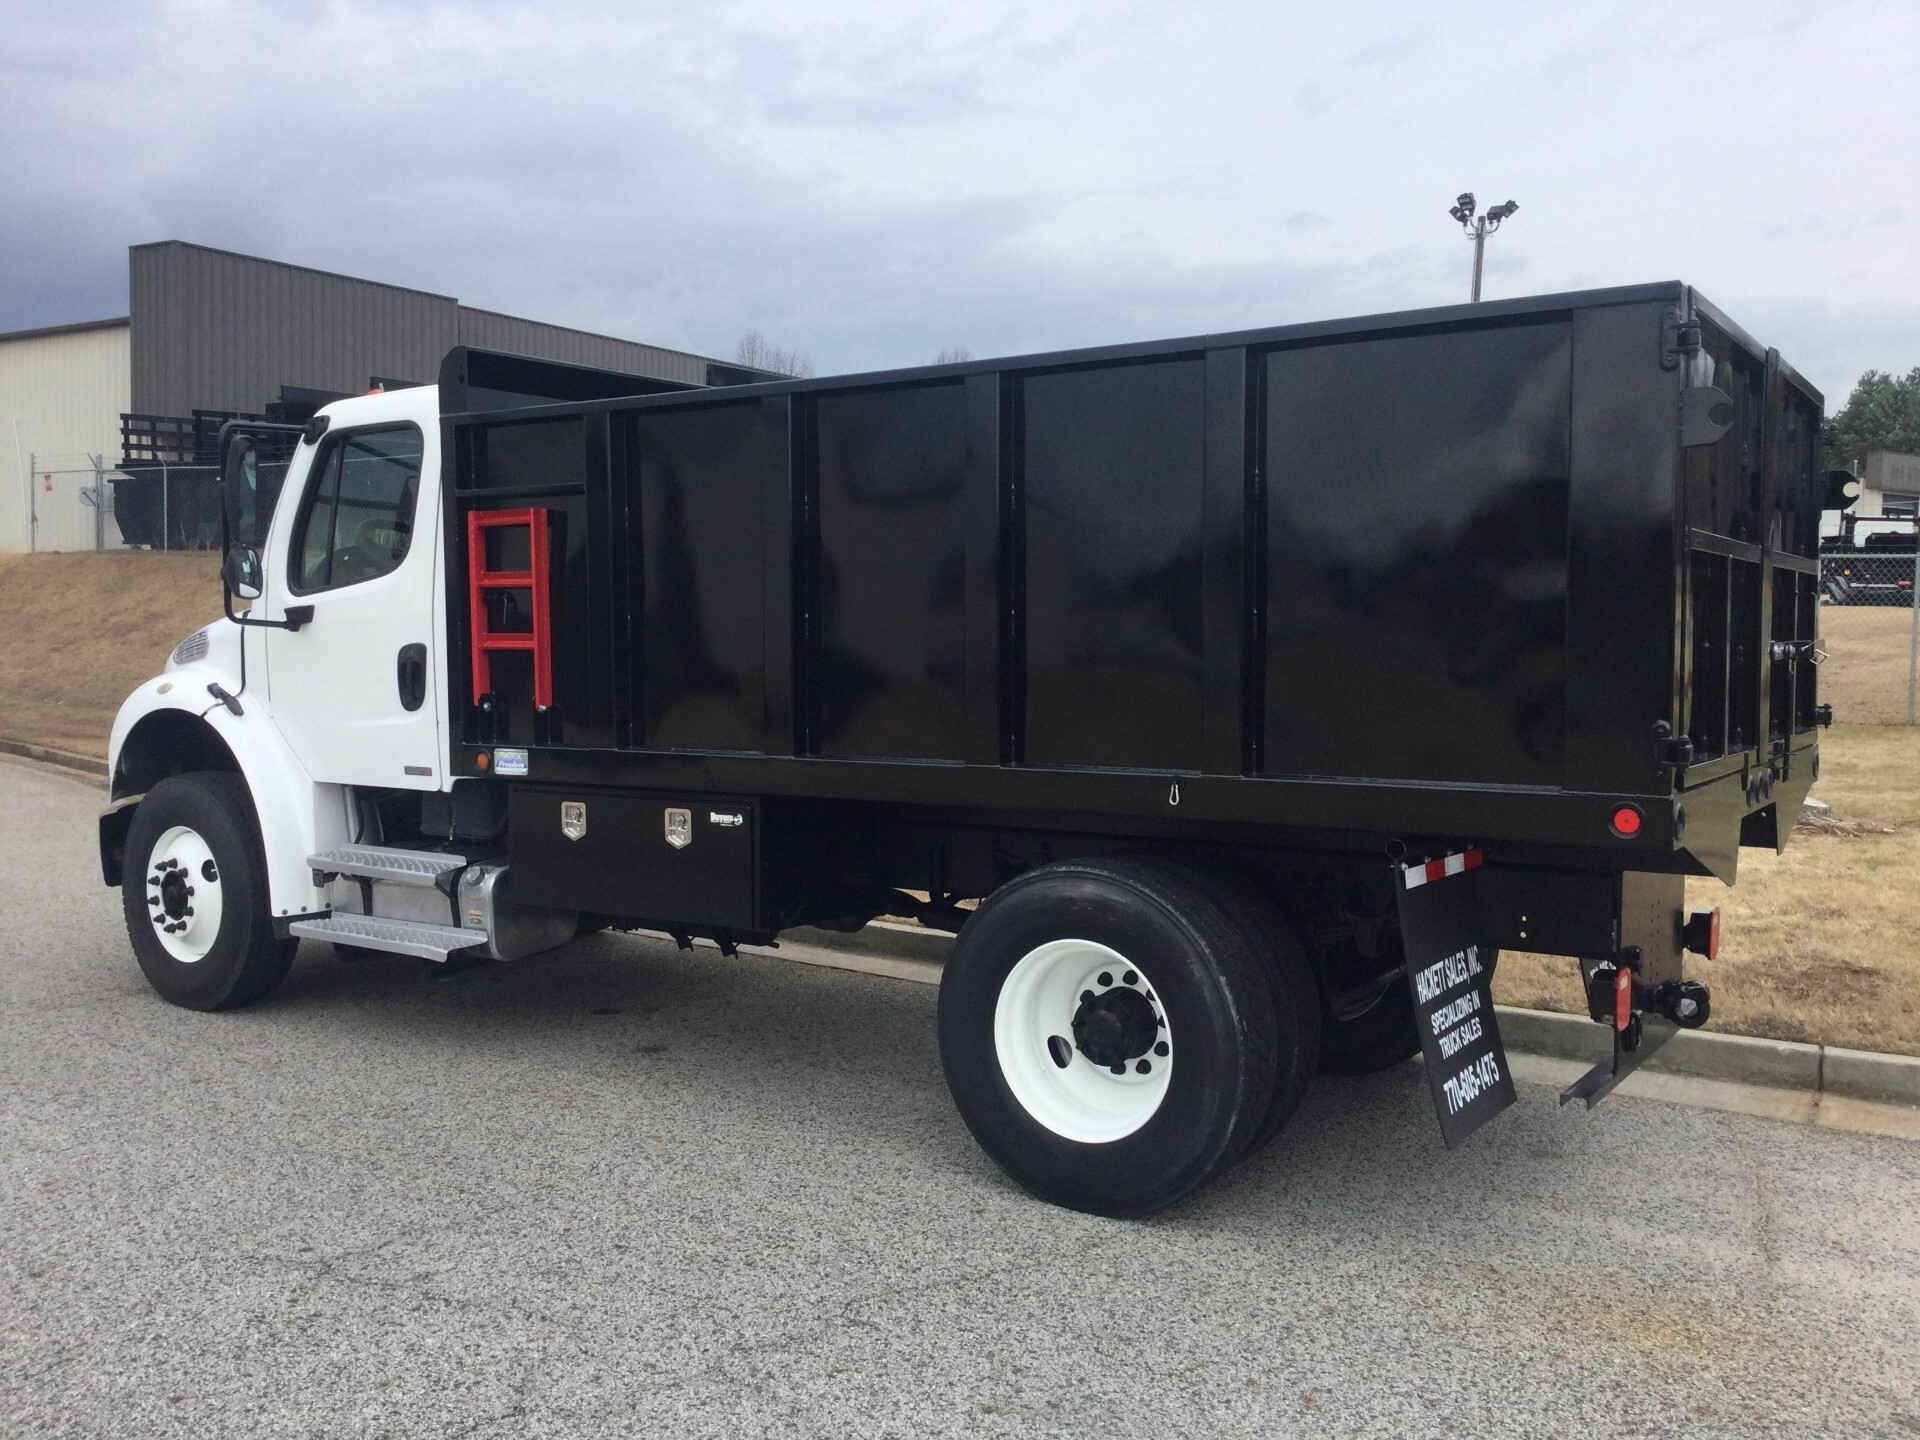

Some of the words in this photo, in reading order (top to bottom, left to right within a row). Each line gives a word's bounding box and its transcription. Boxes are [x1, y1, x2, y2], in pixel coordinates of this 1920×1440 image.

[1415, 960, 1447, 1005] HACKETT
[1444, 950, 1470, 988] SALES,
[1466, 944, 1483, 977] INC.
[1431, 993, 1473, 1035] SPECIALIZING
[1471, 989, 1481, 1011] IN
[1439, 1028, 1463, 1060] TRUCK
[1460, 1016, 1483, 1046] SALES
[1443, 1051, 1500, 1115] 770-605-1475
